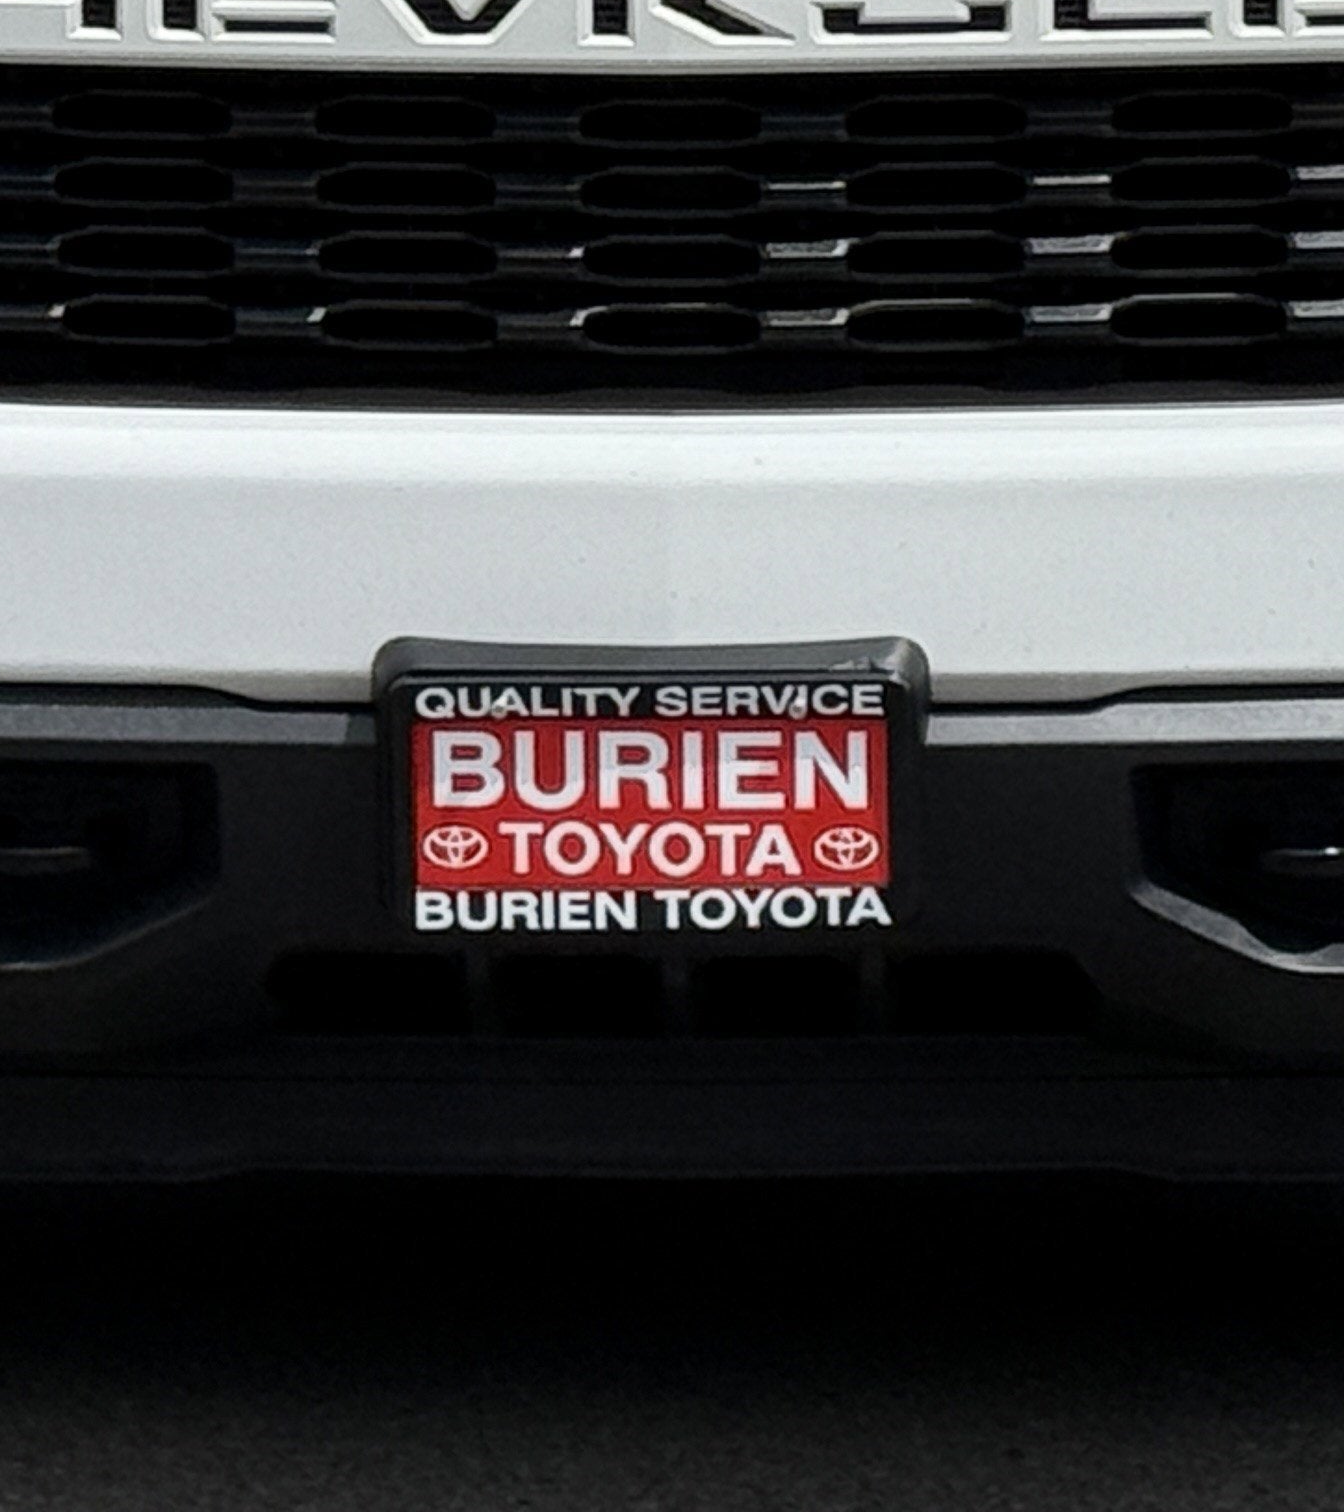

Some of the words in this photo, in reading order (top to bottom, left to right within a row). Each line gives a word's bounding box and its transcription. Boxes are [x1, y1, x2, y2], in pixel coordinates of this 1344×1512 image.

[414, 686, 639, 719] QUALITY
[655, 684, 886, 717] SERVICE
[430, 729, 869, 811] BURIEN
[497, 820, 802, 877] TOYOTA
[414, 891, 638, 931] BURIEN
[653, 887, 893, 929] TOYOTA
